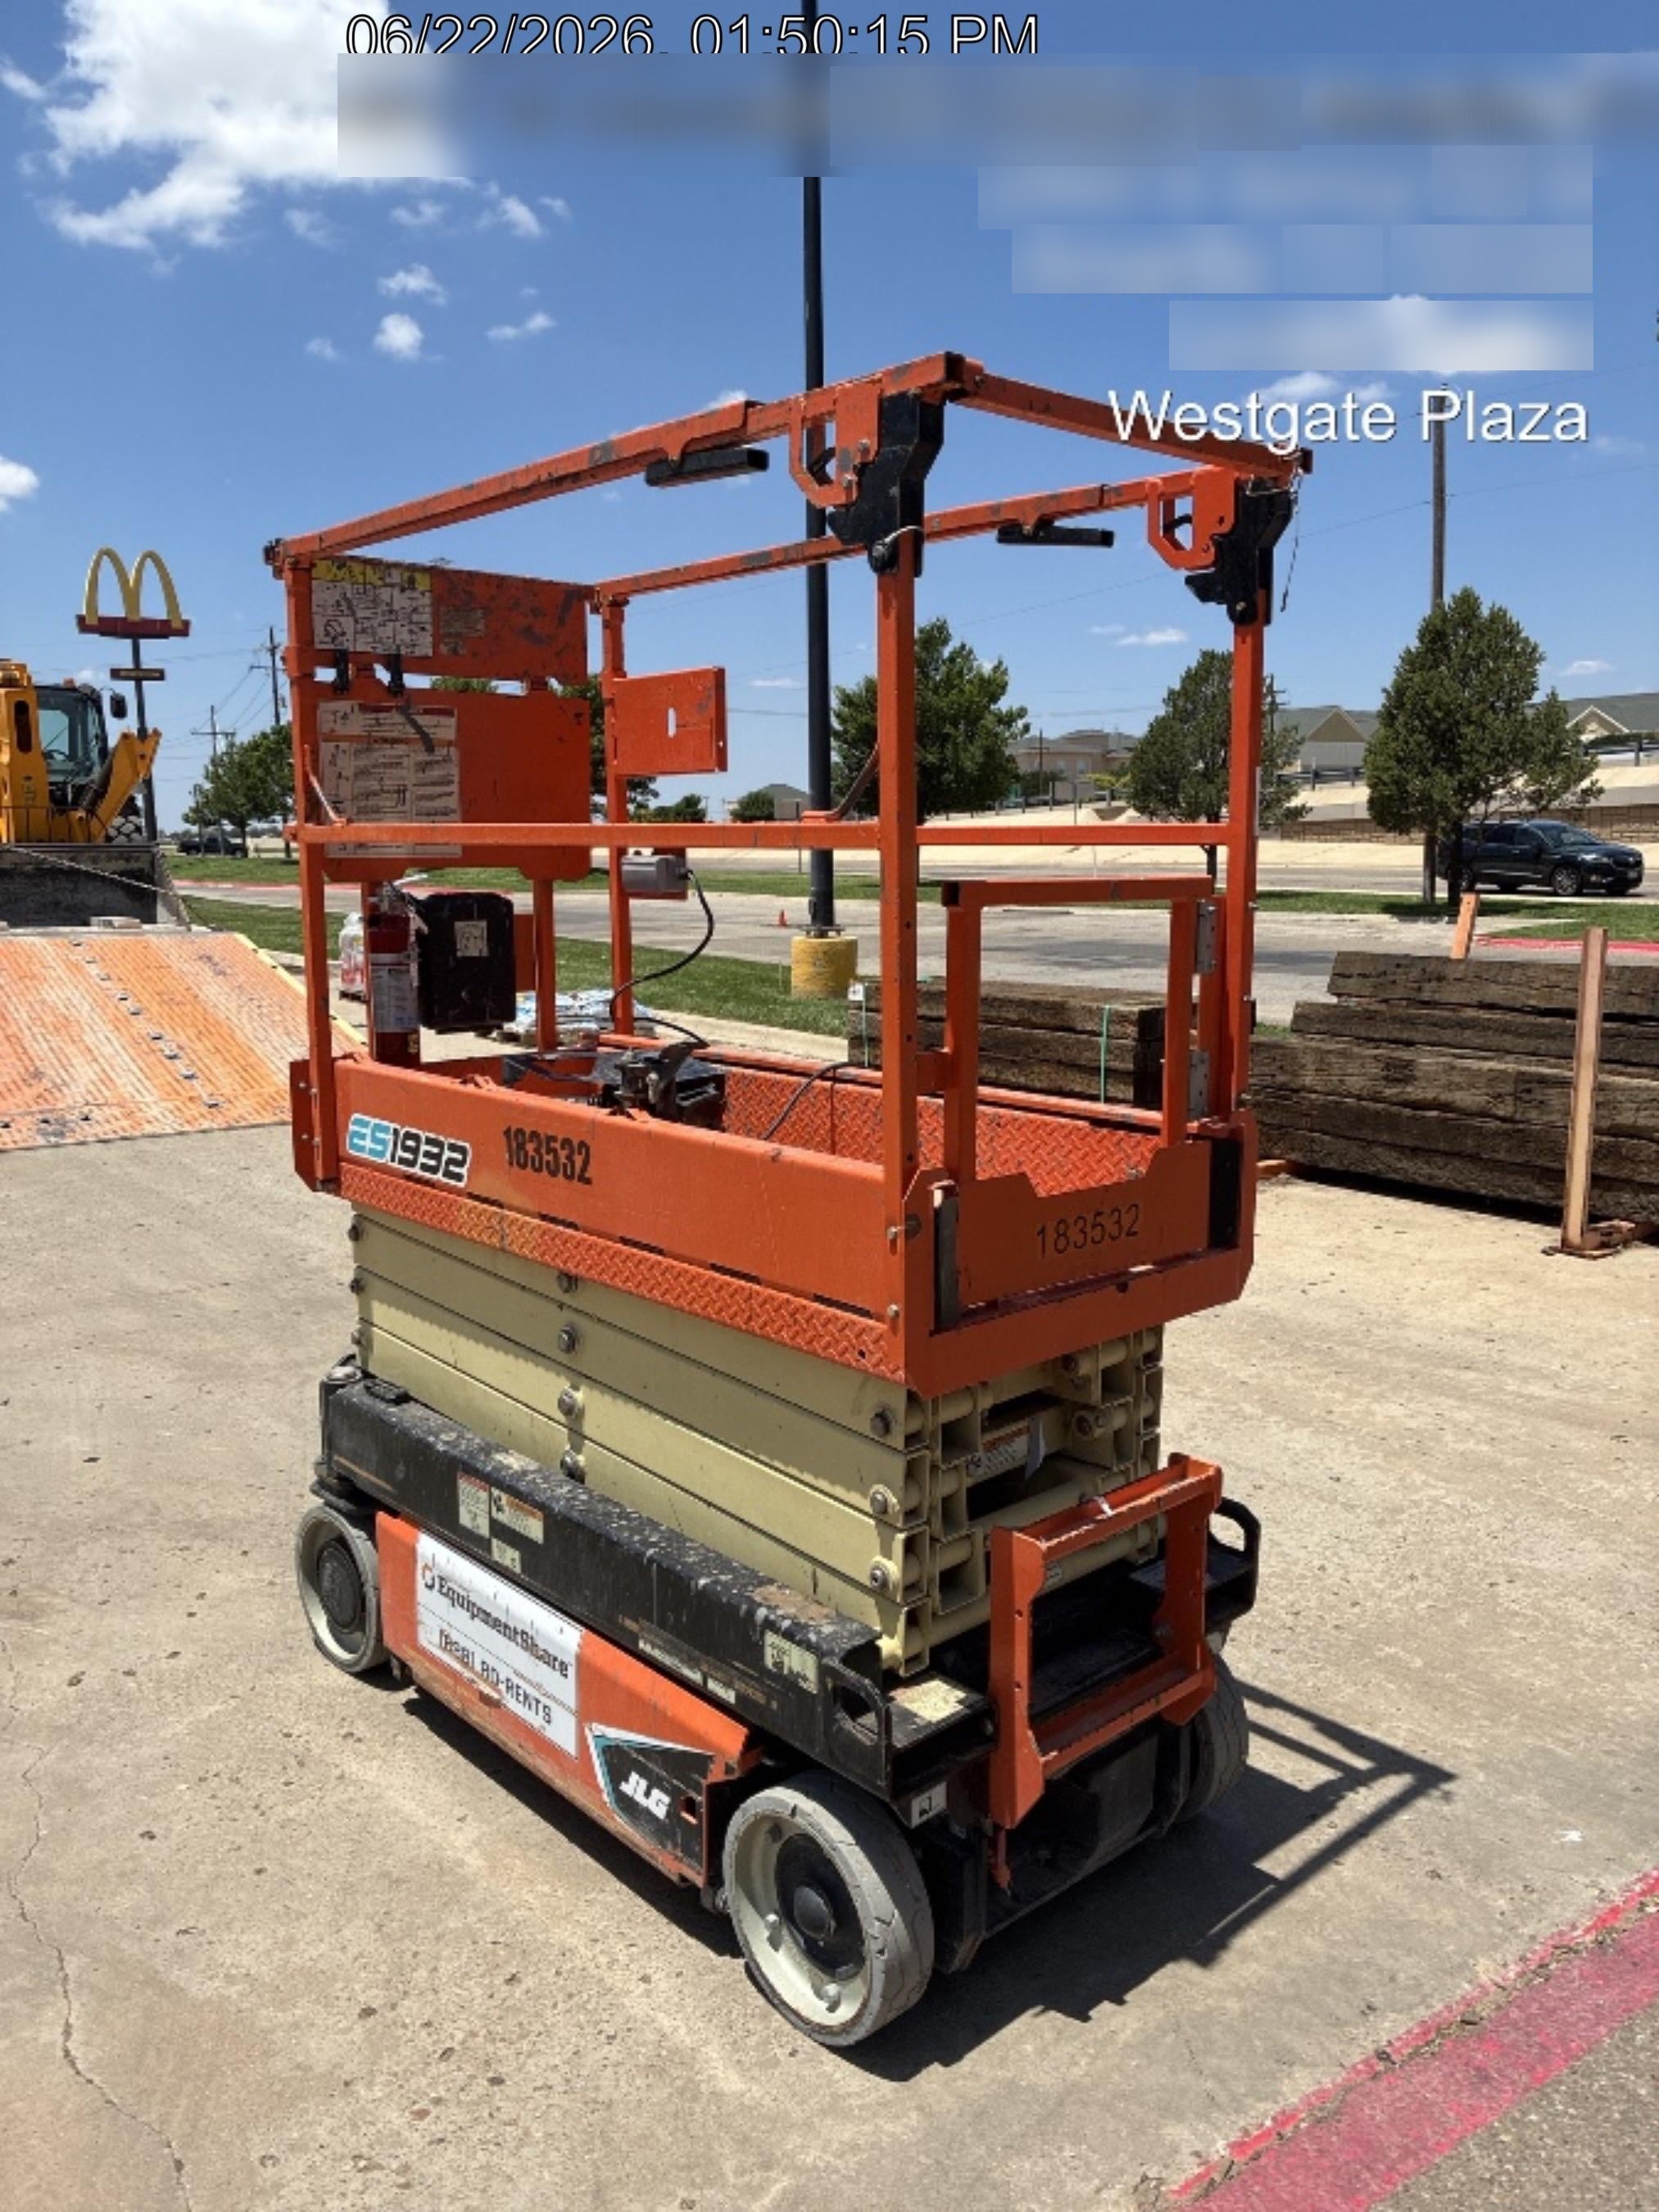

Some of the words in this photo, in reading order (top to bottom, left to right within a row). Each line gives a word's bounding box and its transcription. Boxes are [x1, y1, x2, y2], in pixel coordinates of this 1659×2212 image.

[347, 1115, 469, 1185] ES1932
[503, 1125, 592, 1185] 183532
[1036, 1203, 1140, 1258] 183532
[437, 1575, 569, 1679] EquipmentShare
[619, 1770, 671, 1820] JLG
